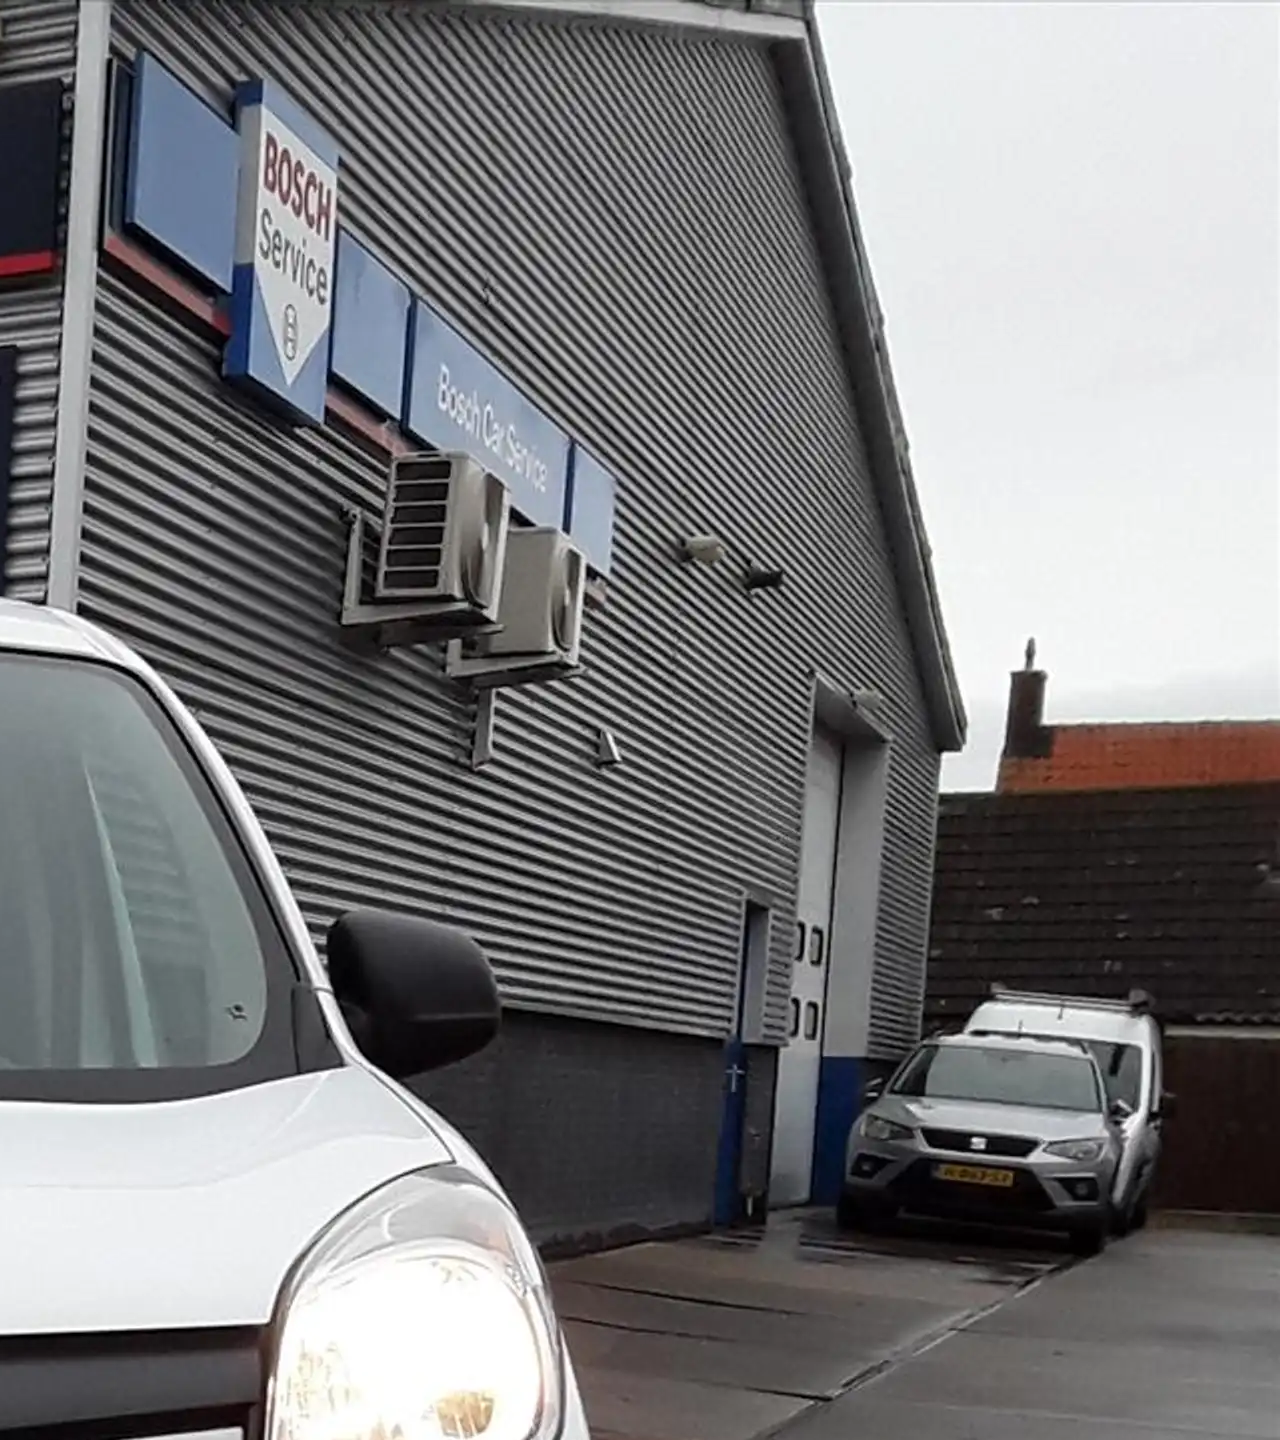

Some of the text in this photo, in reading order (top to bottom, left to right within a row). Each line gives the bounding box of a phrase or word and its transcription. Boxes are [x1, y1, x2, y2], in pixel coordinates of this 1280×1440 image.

[262, 130, 333, 242] BOSCH
[259, 207, 328, 306] Service
[438, 362, 481, 441] Bosch
[506, 423, 548, 493] Service
